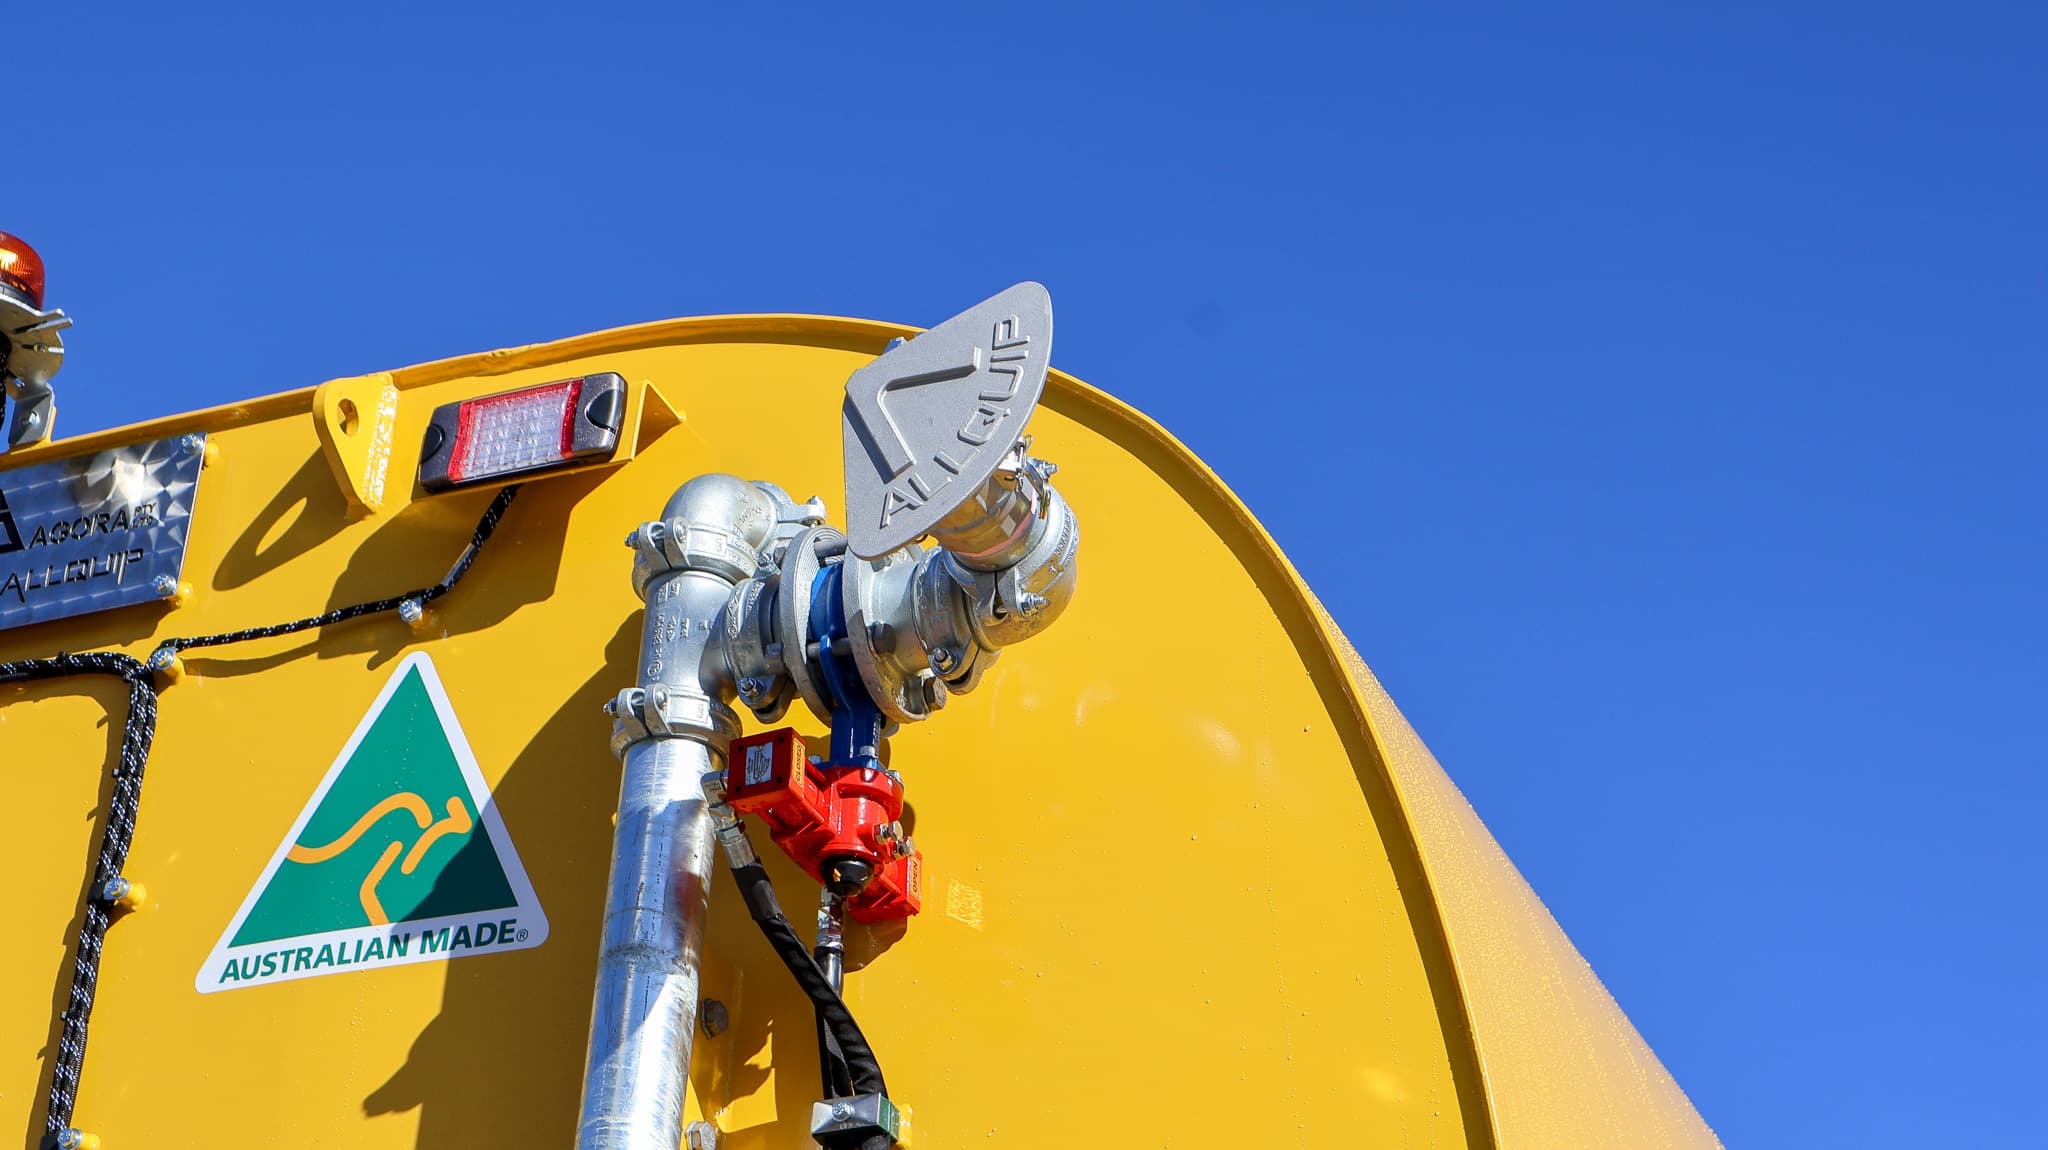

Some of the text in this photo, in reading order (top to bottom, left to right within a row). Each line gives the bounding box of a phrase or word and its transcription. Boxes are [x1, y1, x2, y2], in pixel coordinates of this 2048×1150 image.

[880, 314, 1030, 530] ALLQUIP
[29, 509, 154, 549] AGORA LTD
[134, 502, 157, 516] PTY
[0, 548, 144, 604] ALLQUIP
[911, 861, 919, 893] OPEN
[218, 932, 411, 984] AUSTRALIAN
